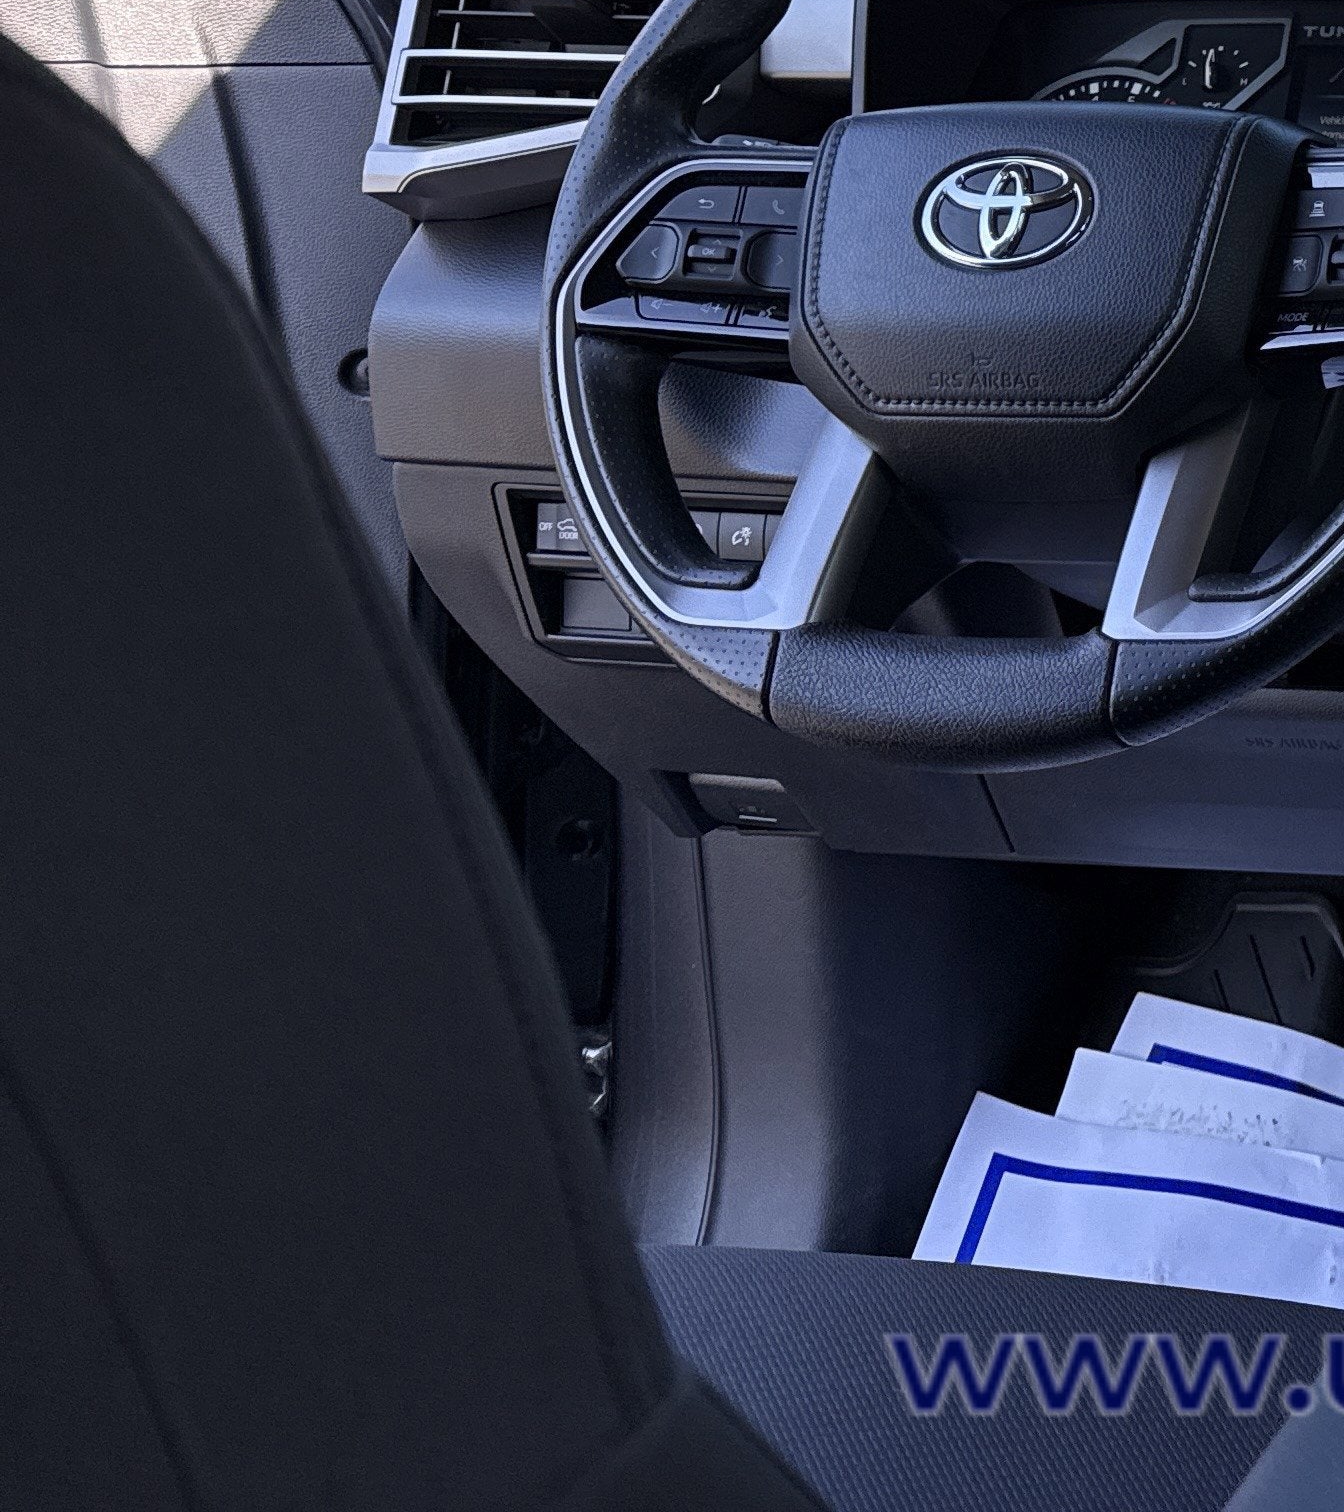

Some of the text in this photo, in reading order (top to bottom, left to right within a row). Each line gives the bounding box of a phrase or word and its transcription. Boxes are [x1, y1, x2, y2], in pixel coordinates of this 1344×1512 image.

[1276, 312, 1309, 322] MODE
[928, 371, 1040, 390] SRS AIRBAG
